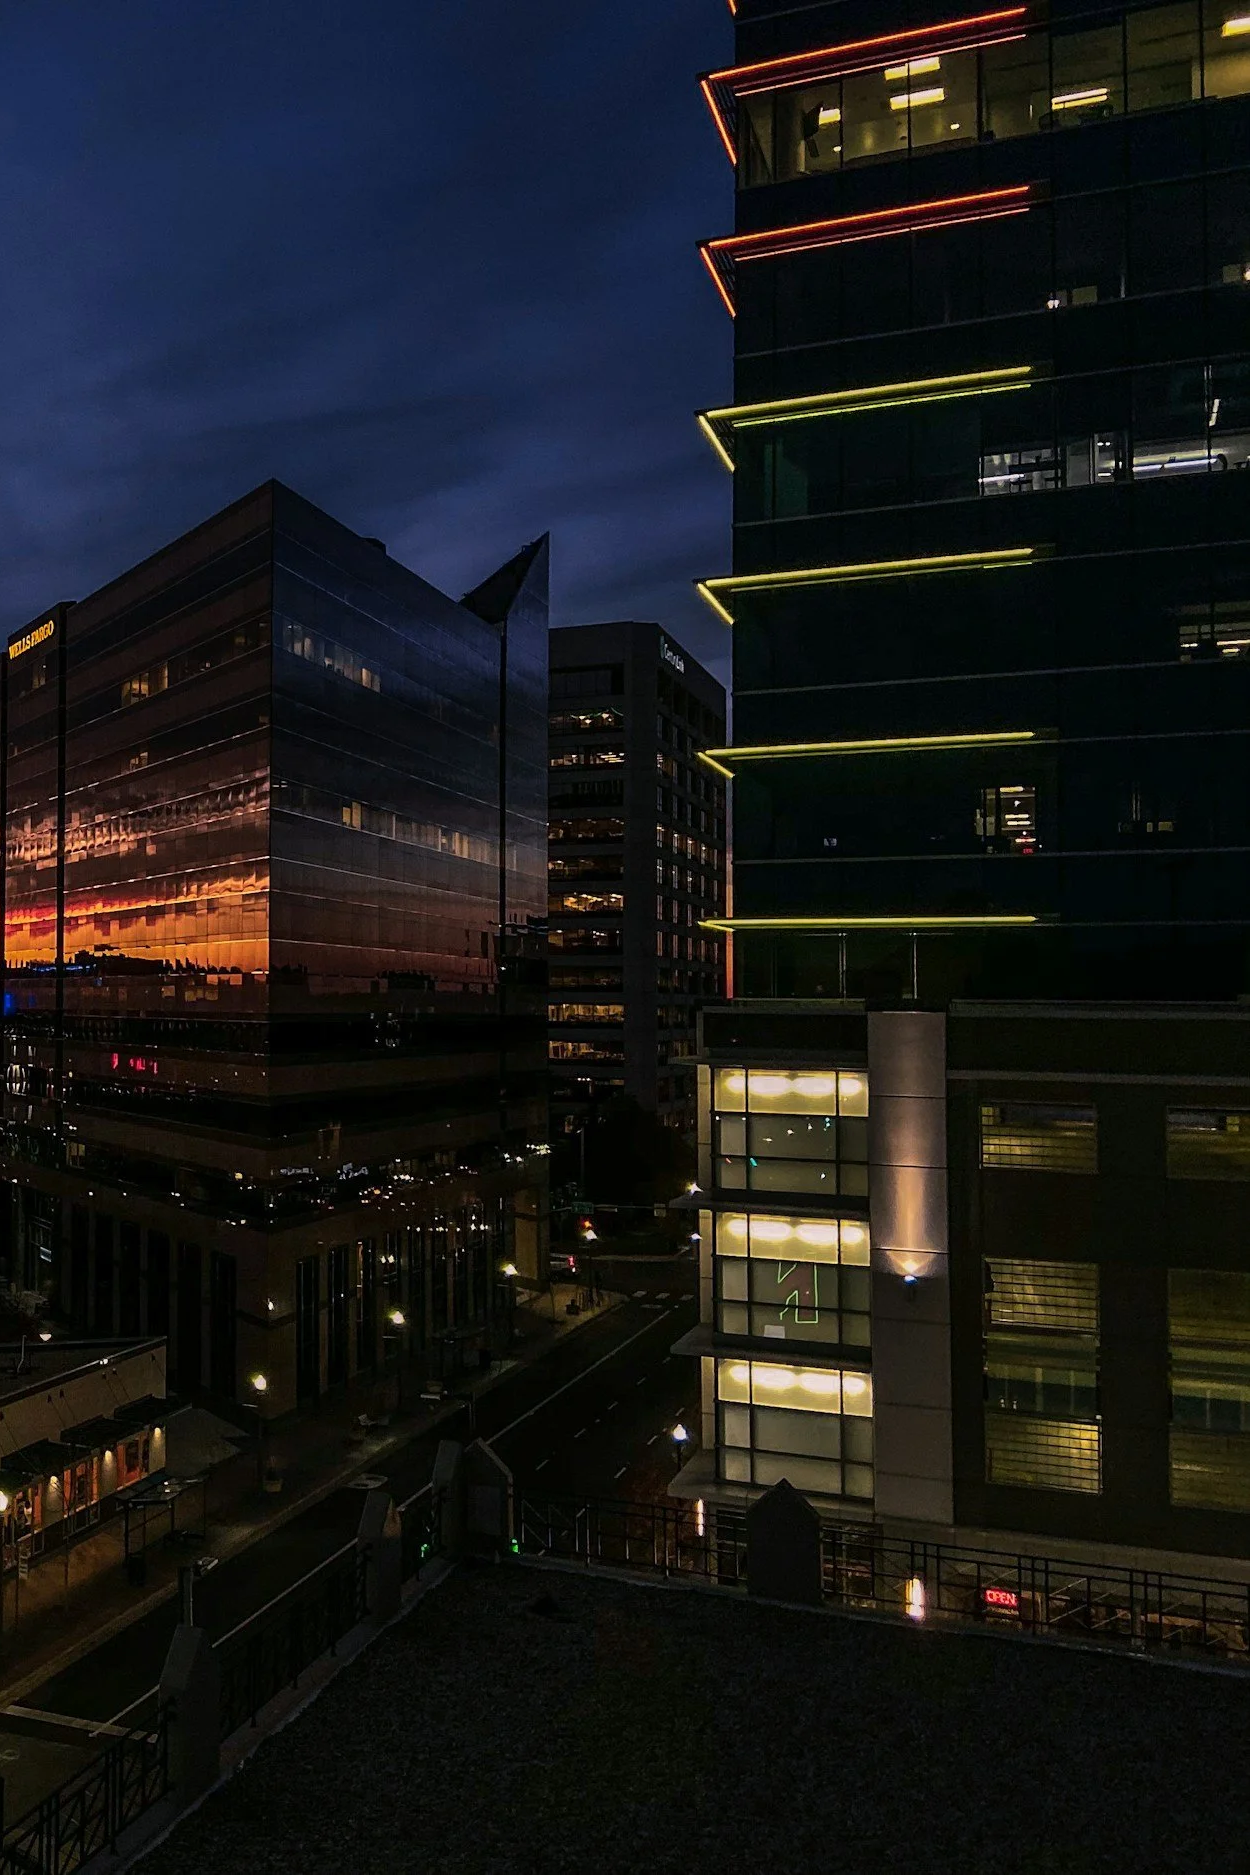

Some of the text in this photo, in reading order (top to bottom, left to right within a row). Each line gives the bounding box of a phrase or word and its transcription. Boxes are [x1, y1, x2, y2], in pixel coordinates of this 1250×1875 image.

[9, 620, 54, 659] WELLS FARGO
[985, 1588, 1017, 1606] OPEN
